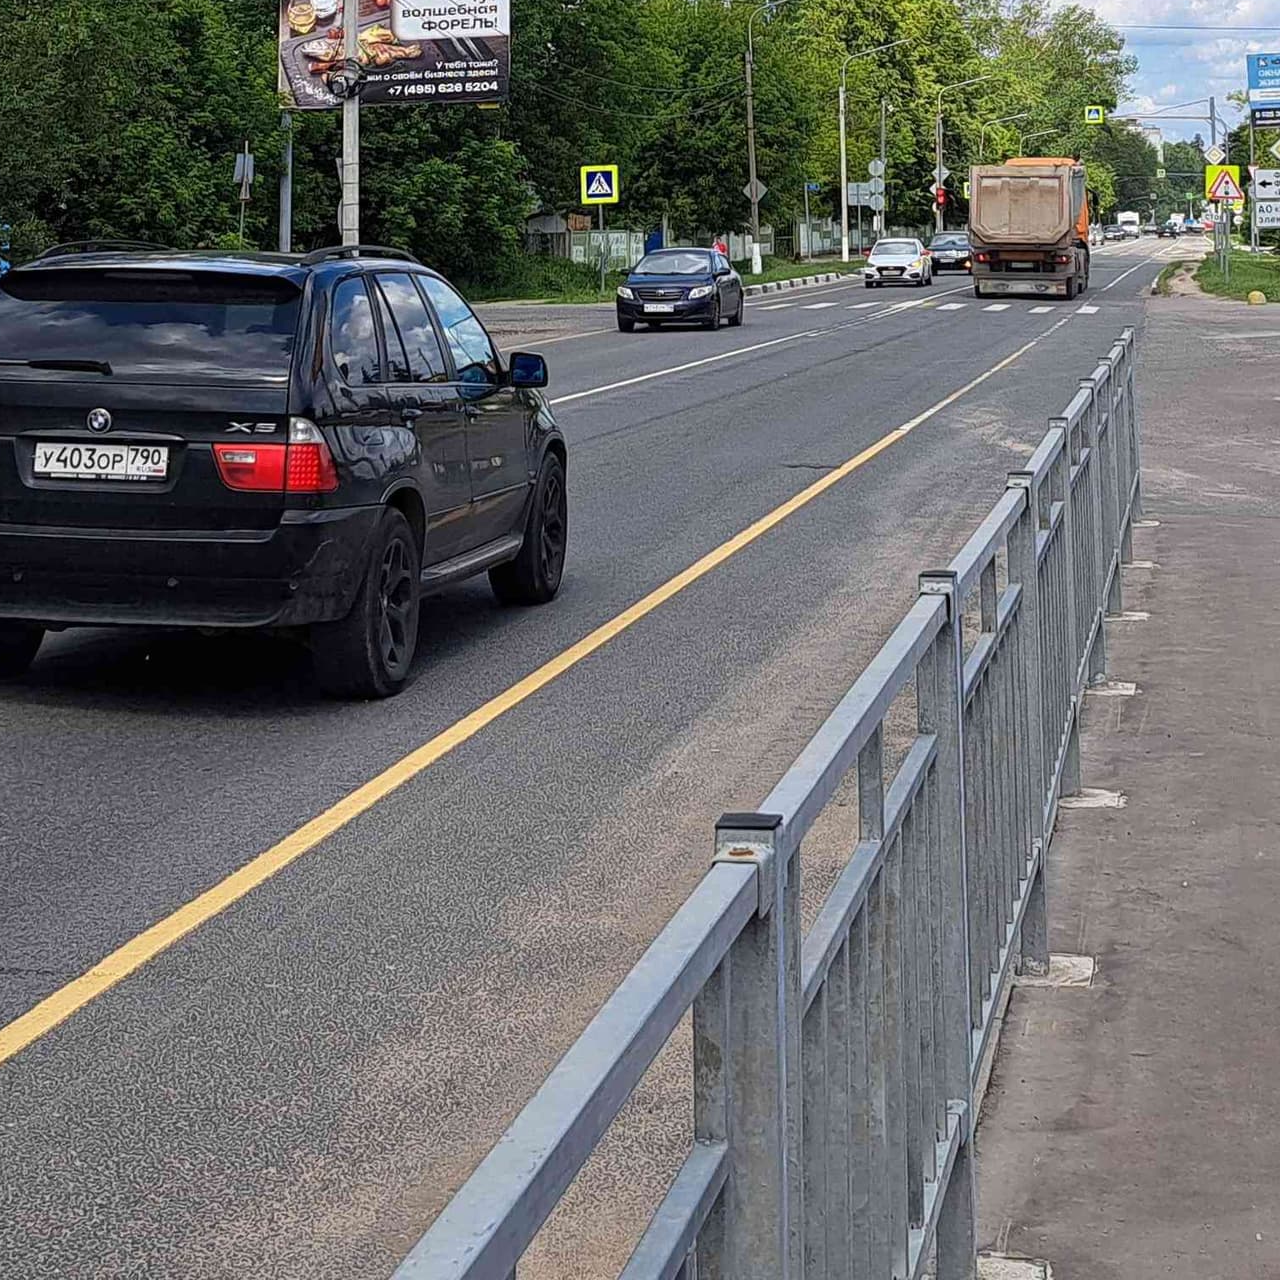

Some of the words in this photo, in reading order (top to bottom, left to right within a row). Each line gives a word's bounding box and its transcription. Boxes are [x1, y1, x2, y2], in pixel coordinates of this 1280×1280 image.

[402, 4, 498, 18] волшебная
[421, 18, 498, 31] ФОРЕЛЬ!
[435, 61, 443, 69] У
[444, 60, 467, 69] тебя
[424, 70, 465, 79] бизнесе
[388, 86, 402, 96] +7
[404, 84, 435, 96] (495)
[465, 81, 498, 91] 5204
[1258, 204, 1273, 213] АО
[224, 421, 277, 434] X5
[43, 446, 123, 470] У403ОР
[130, 448, 161, 465] 790
